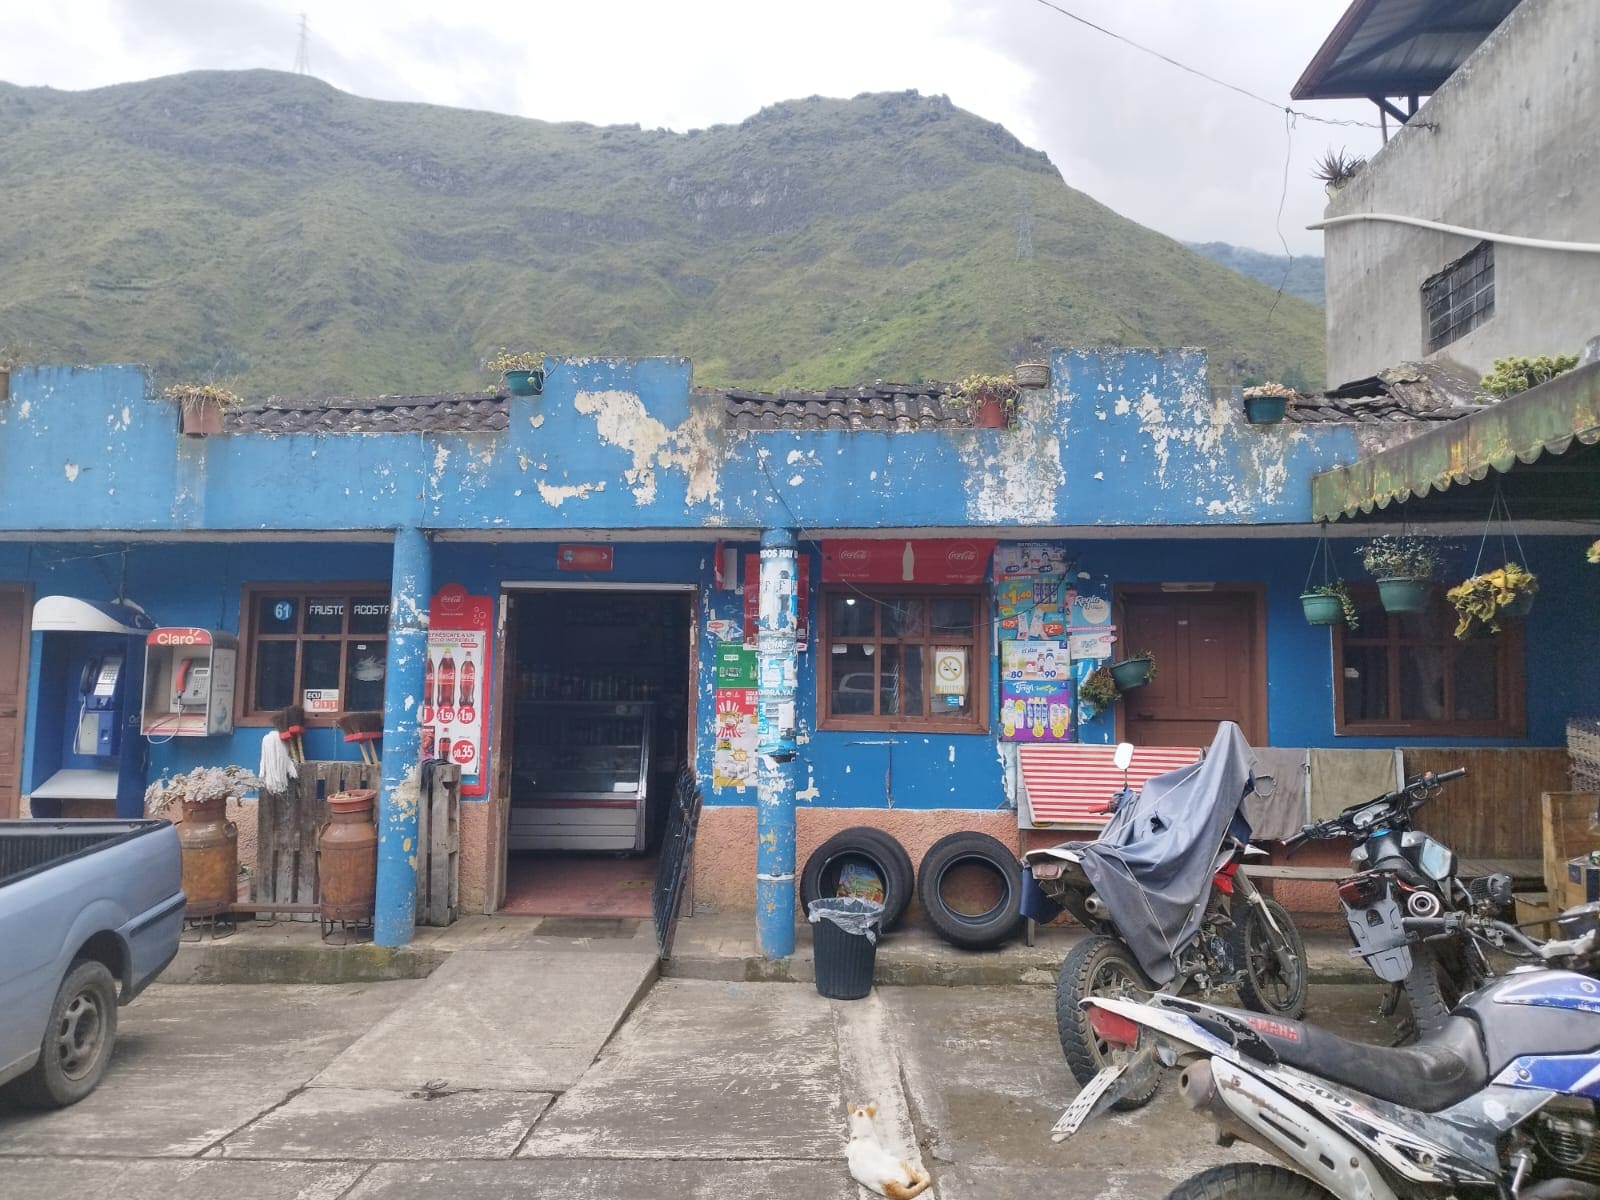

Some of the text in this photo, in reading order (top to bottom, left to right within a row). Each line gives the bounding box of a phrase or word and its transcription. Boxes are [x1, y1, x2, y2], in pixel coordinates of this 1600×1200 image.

[779, 549, 793, 558] HAY
[275, 603, 290, 618] 61
[156, 633, 194, 645] Claro
